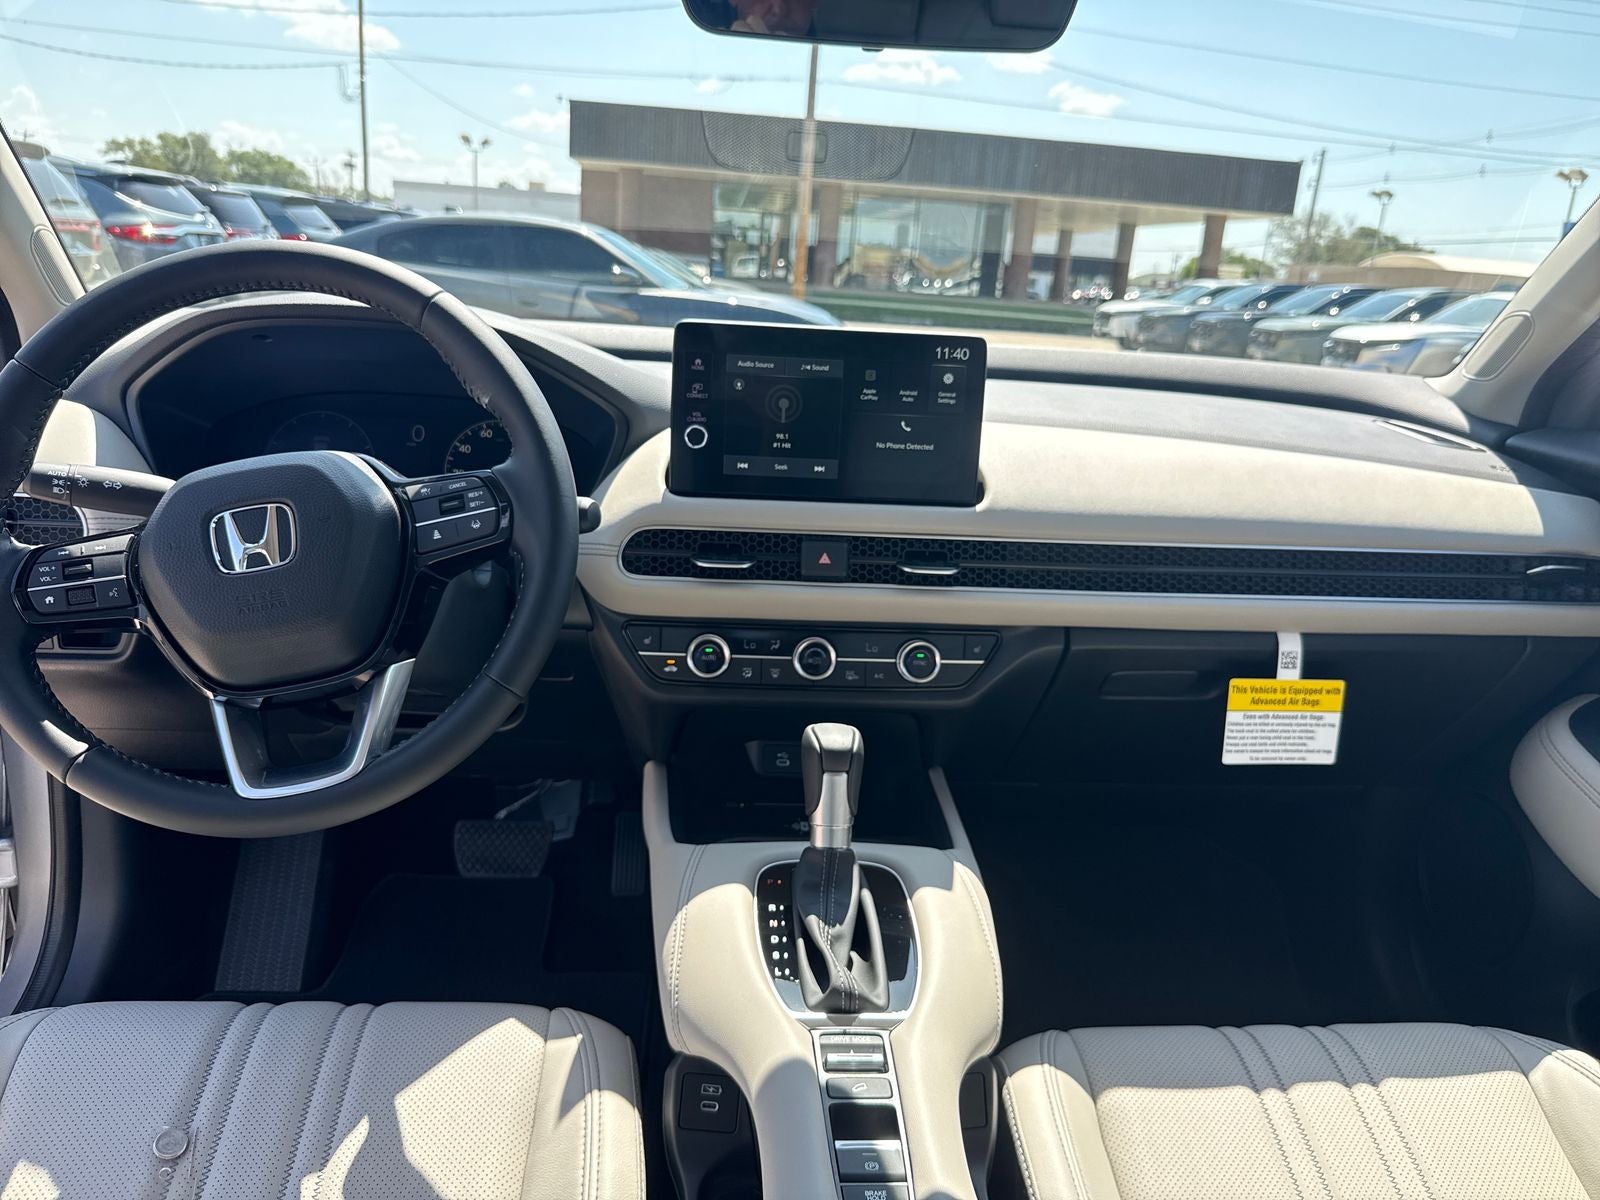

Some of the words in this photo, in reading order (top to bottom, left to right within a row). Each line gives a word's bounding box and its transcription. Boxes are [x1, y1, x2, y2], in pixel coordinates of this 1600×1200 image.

[935, 347, 970, 361] 11:40
[737, 360, 754, 368] Audio
[755, 361, 774, 369] Source
[480, 429, 493, 438] 60
[459, 445, 471, 454] 40
[906, 443, 934, 451] Detected
[449, 481, 467, 490] CANCEL
[1232, 685, 1247, 694] This
[1249, 685, 1278, 694] Vehicle
[1279, 685, 1286, 694] is
[1288, 686, 1323, 696] Equipped
[1324, 687, 1341, 695] with
[1250, 697, 1287, 705] Advanced
[1288, 697, 1299, 705] Air
[1301, 697, 1320, 706] Bags
[768, 903, 776, 911] R
[769, 919, 778, 928] N
[770, 935, 779, 944] D
[774, 966, 782, 976] L
